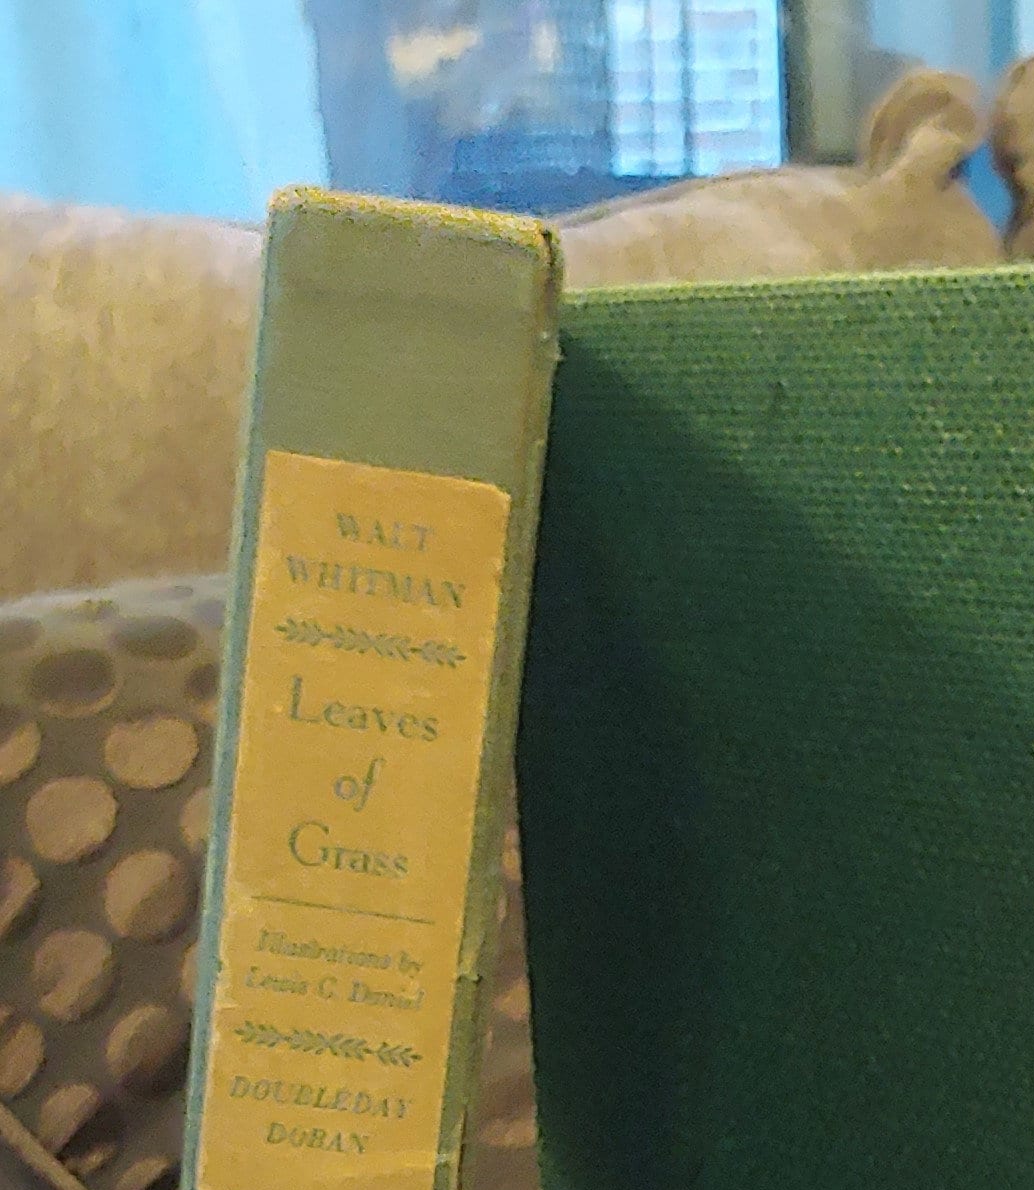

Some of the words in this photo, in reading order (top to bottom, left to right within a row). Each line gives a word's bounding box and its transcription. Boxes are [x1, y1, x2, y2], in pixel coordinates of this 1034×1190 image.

[336, 512, 434, 552] WALT
[286, 555, 466, 608] WHITMAN
[288, 675, 439, 742] Leaves
[333, 757, 386, 812] of
[288, 820, 409, 880] Grass
[400, 950, 423, 978] by
[229, 1075, 412, 1119] DOUBLEDAY
[266, 1122, 371, 1155] DORAN
